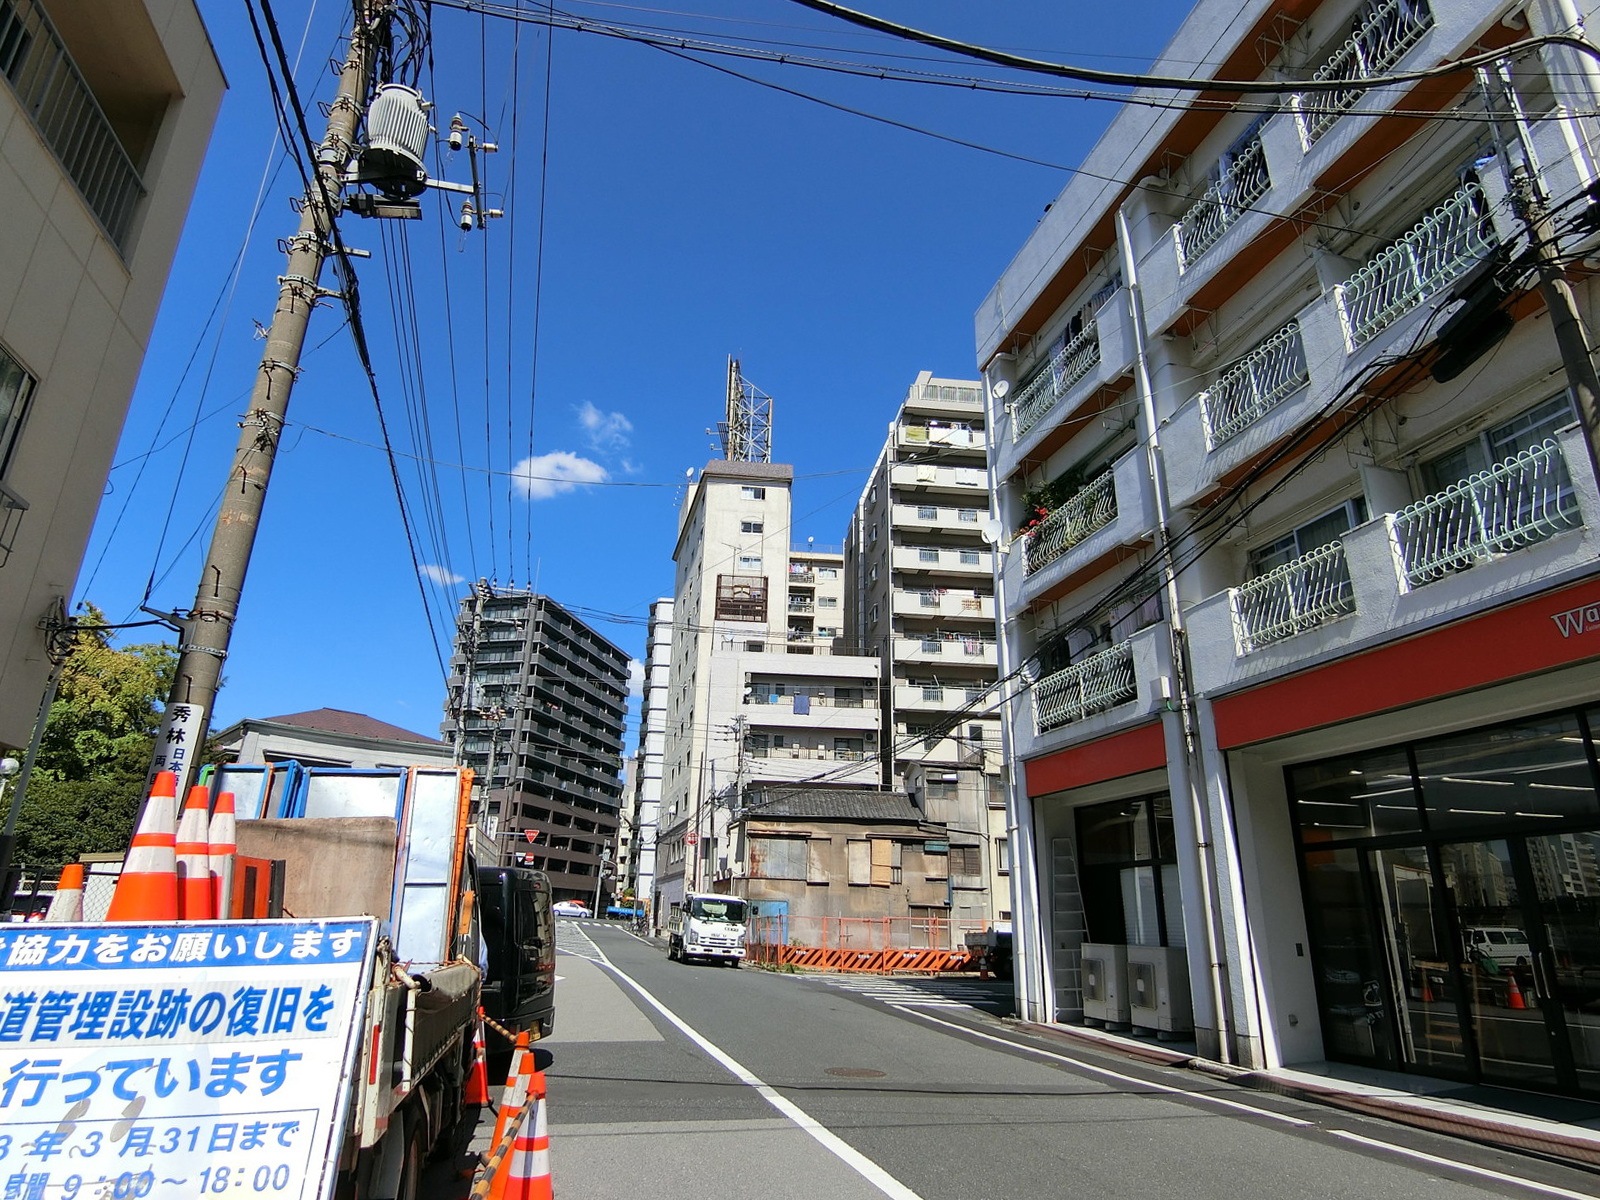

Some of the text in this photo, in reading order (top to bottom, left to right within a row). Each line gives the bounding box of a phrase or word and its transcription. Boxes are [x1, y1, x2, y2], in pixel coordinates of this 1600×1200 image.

[1550, 601, 1600, 638] Wa
[166, 706, 191, 745] 秀林
[0, 929, 362, 966] 協力をお願いします
[0, 984, 334, 1042] 道管埋設跡の復旧を
[1, 1049, 303, 1108] 行っています
